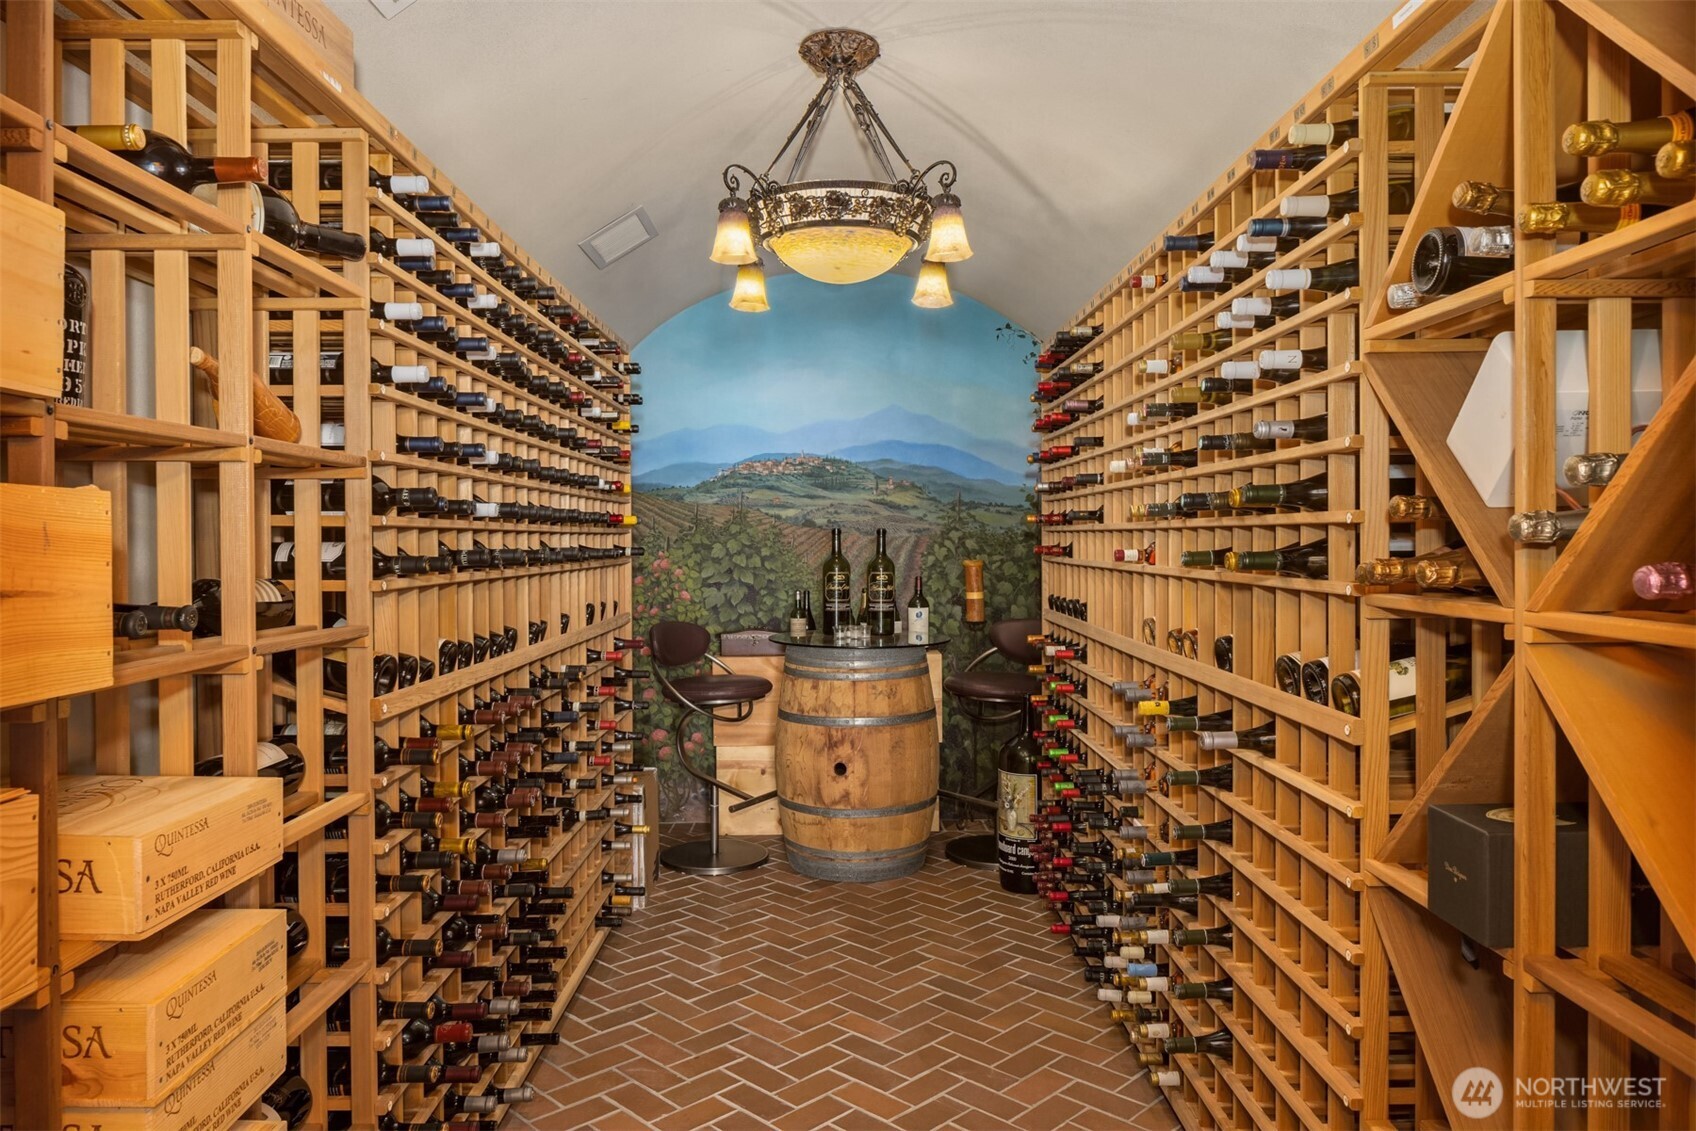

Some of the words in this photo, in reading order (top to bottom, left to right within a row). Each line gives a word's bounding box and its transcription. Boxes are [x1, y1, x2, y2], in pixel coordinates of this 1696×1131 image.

[154, 817, 210, 857] QUINTESSA
[155, 871, 206, 904] RUTHERFORD,
[206, 849, 245, 877] CALIFORNIA
[155, 880, 159, 890] 3
[159, 877, 166, 887] X
[155, 901, 176, 918] NAPA
[176, 882, 205, 905] VALLEY
[205, 876, 219, 890] RED
[220, 865, 237, 880] WINE
[165, 970, 217, 1020] QUINTESSA
[165, 1060, 185, 1082] NAPA
[185, 1035, 213, 1065] VALLEY
[213, 1026, 227, 1043] RED
[226, 1011, 243, 1029] WINE
[166, 1024, 214, 1068] RUTHERFORD,
[213, 994, 251, 1029] CALIFORNIA
[212, 1081, 250, 1117] CALIFORNIA
